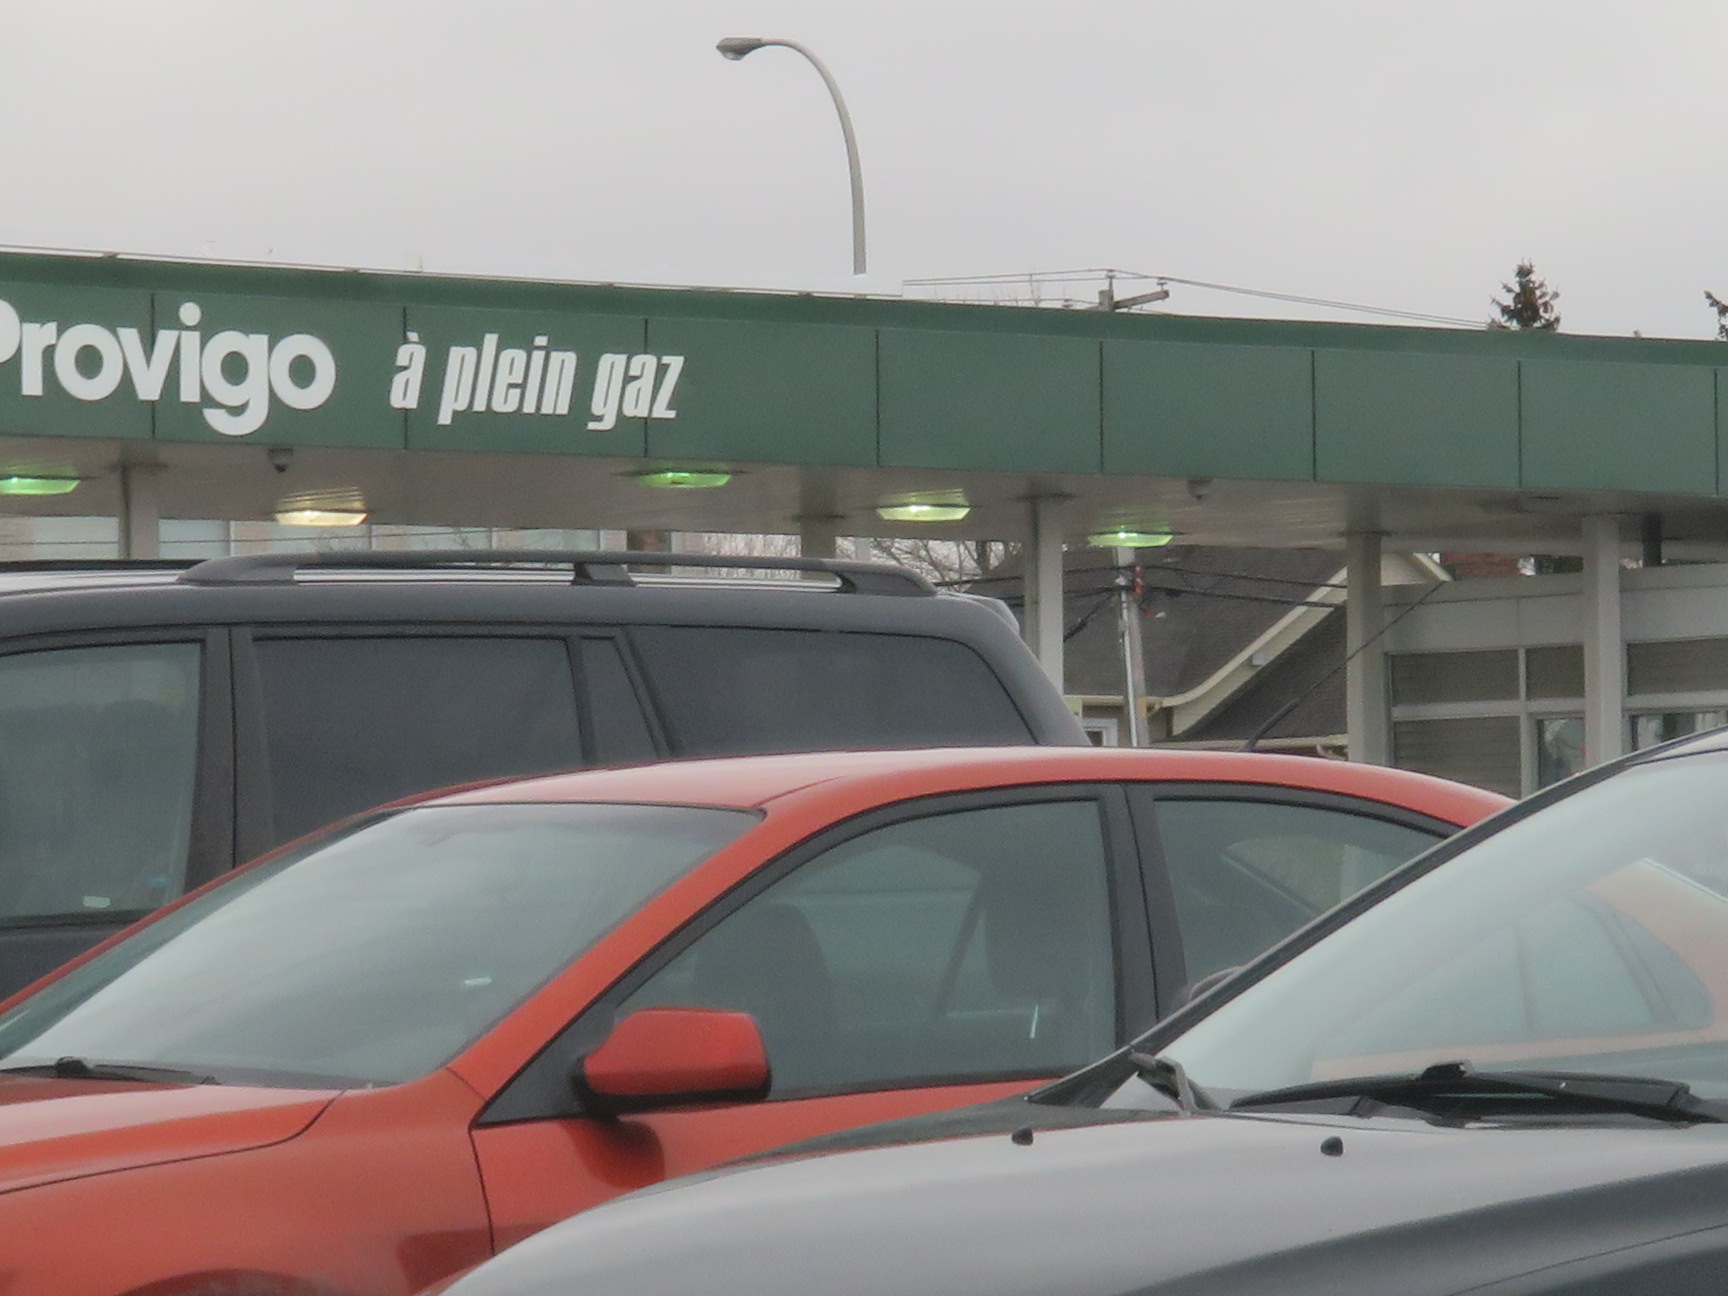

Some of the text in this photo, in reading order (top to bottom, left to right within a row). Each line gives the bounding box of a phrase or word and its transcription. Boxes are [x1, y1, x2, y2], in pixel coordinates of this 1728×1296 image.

[389, 330, 427, 410] à
[436, 332, 578, 425] plein
[586, 352, 686, 431] gaz
